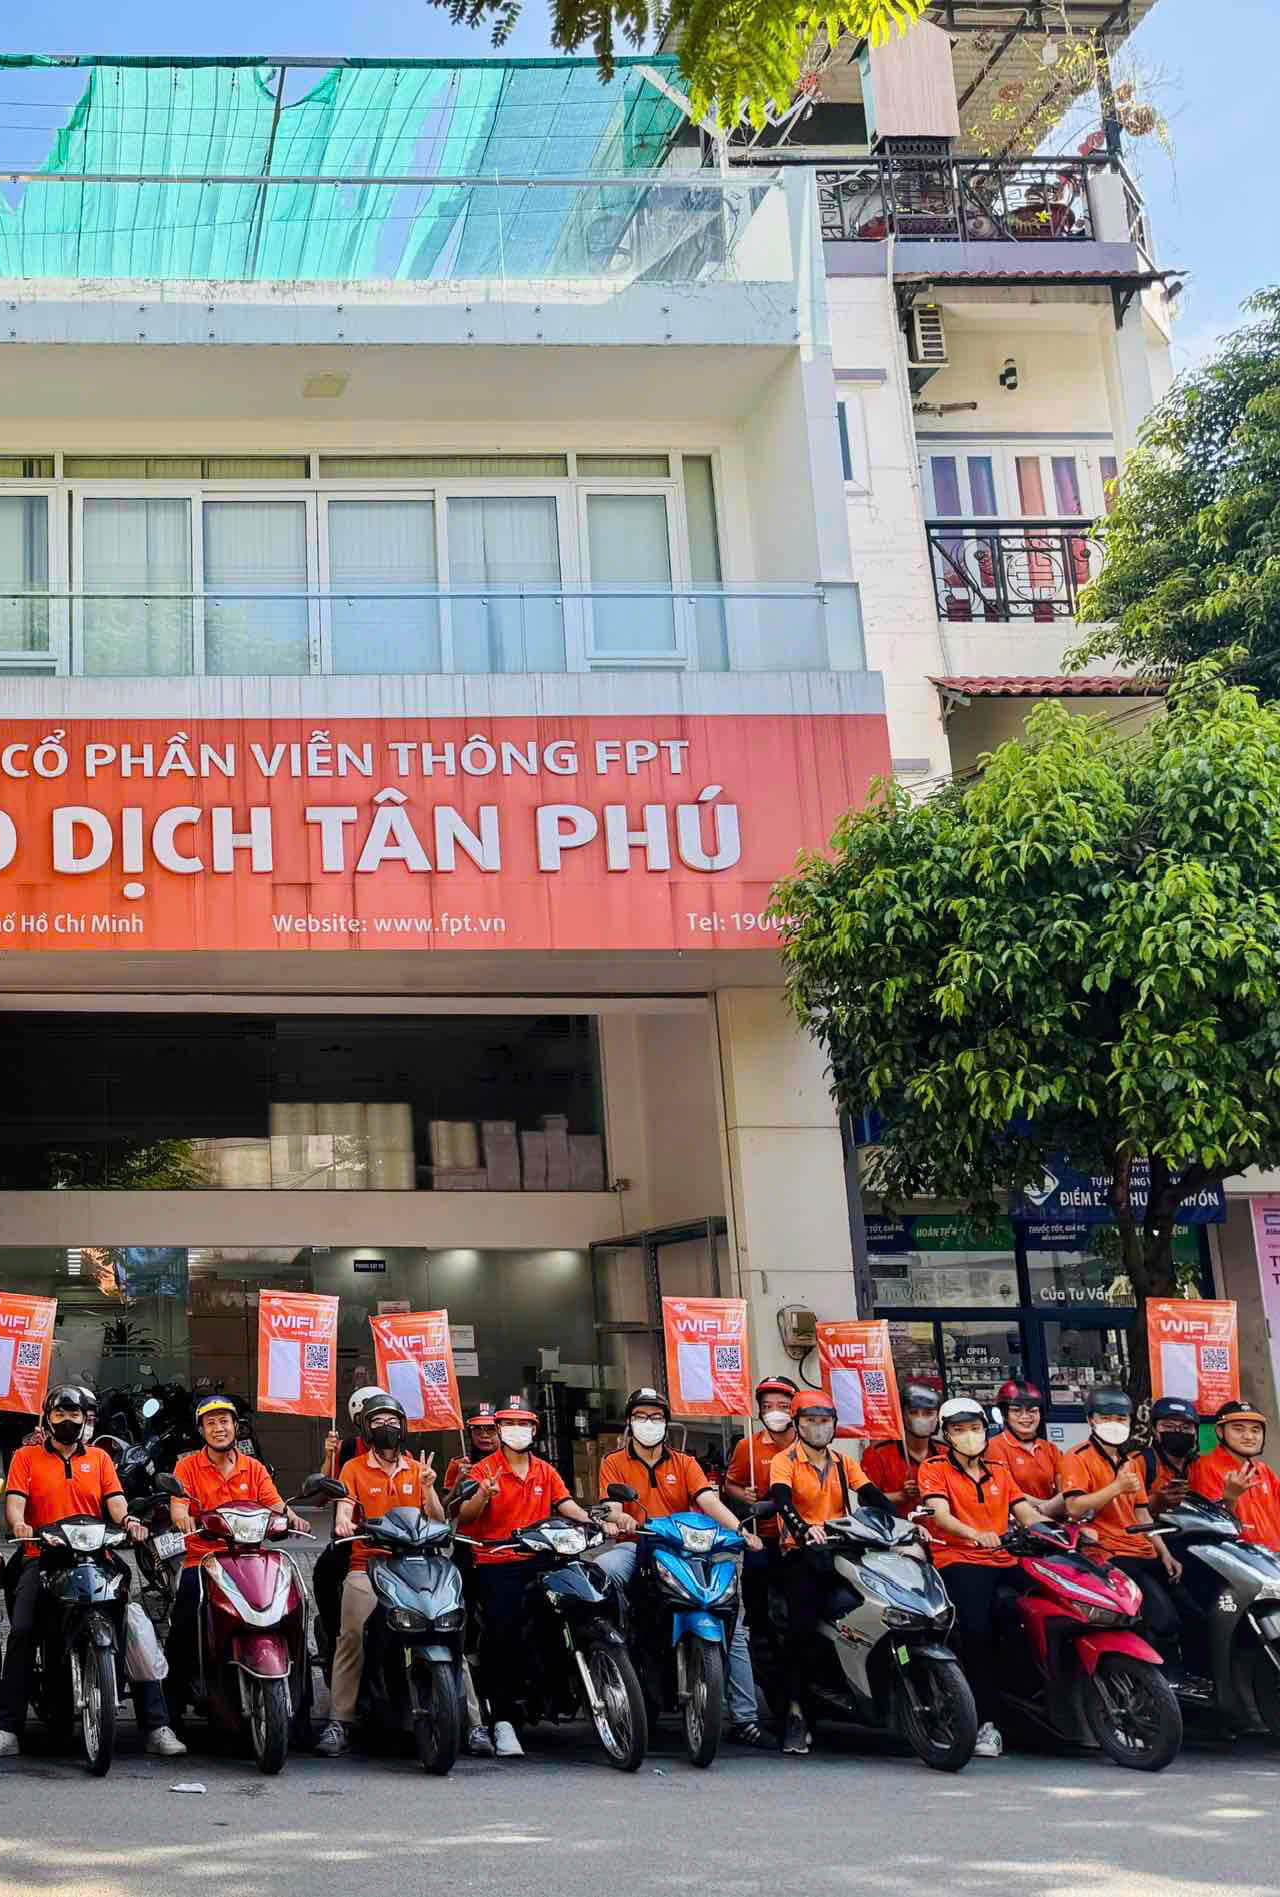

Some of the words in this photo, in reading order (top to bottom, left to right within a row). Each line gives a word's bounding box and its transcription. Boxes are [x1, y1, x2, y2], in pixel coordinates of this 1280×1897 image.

[1, 729, 68, 778] CỔ
[85, 731, 235, 777] PHẦN
[250, 730, 373, 777] VIỄN
[388, 734, 579, 776] THÔNG
[595, 740, 689, 775] FPT
[53, 806, 273, 899] DỊCH
[306, 787, 501, 873] TÂN
[536, 784, 742, 873] PHÚ
[21, 912, 48, 933] Hồ
[54, 912, 86, 933] Chí
[91, 913, 144, 933] Minh
[272, 912, 368, 933] Website:
[374, 912, 507, 937] www.fpt.vn
[687, 912, 725, 932] Tel:
[271, 1314, 315, 1329] WIFI
[676, 1319, 721, 1333] WIFI
[1160, 1319, 1209, 1334] WIFI
[828, 1343, 866, 1358] WIFI
